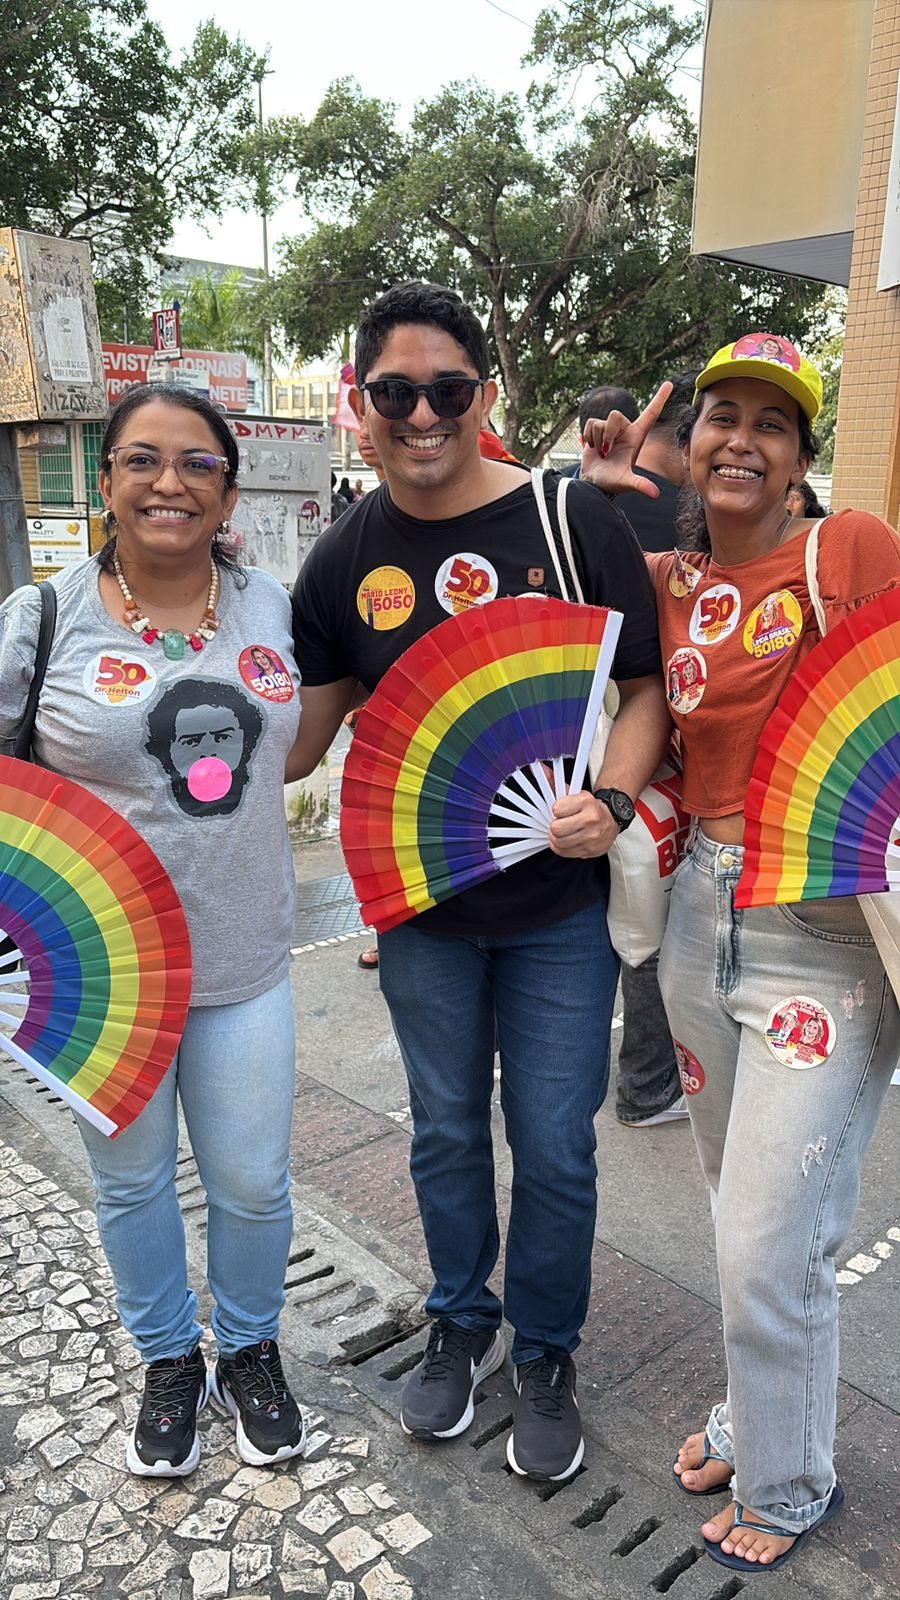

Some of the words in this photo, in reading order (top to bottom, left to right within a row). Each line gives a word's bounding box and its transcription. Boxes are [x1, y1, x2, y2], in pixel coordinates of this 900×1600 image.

[177, 357, 242, 378] JORNAIS
[445, 558, 490, 598] 50
[373, 594, 413, 612] 5050
[698, 594, 735, 629] 50
[753, 633, 796, 659] 50180
[95, 655, 147, 686] 50
[250, 672, 292, 693] 50180
